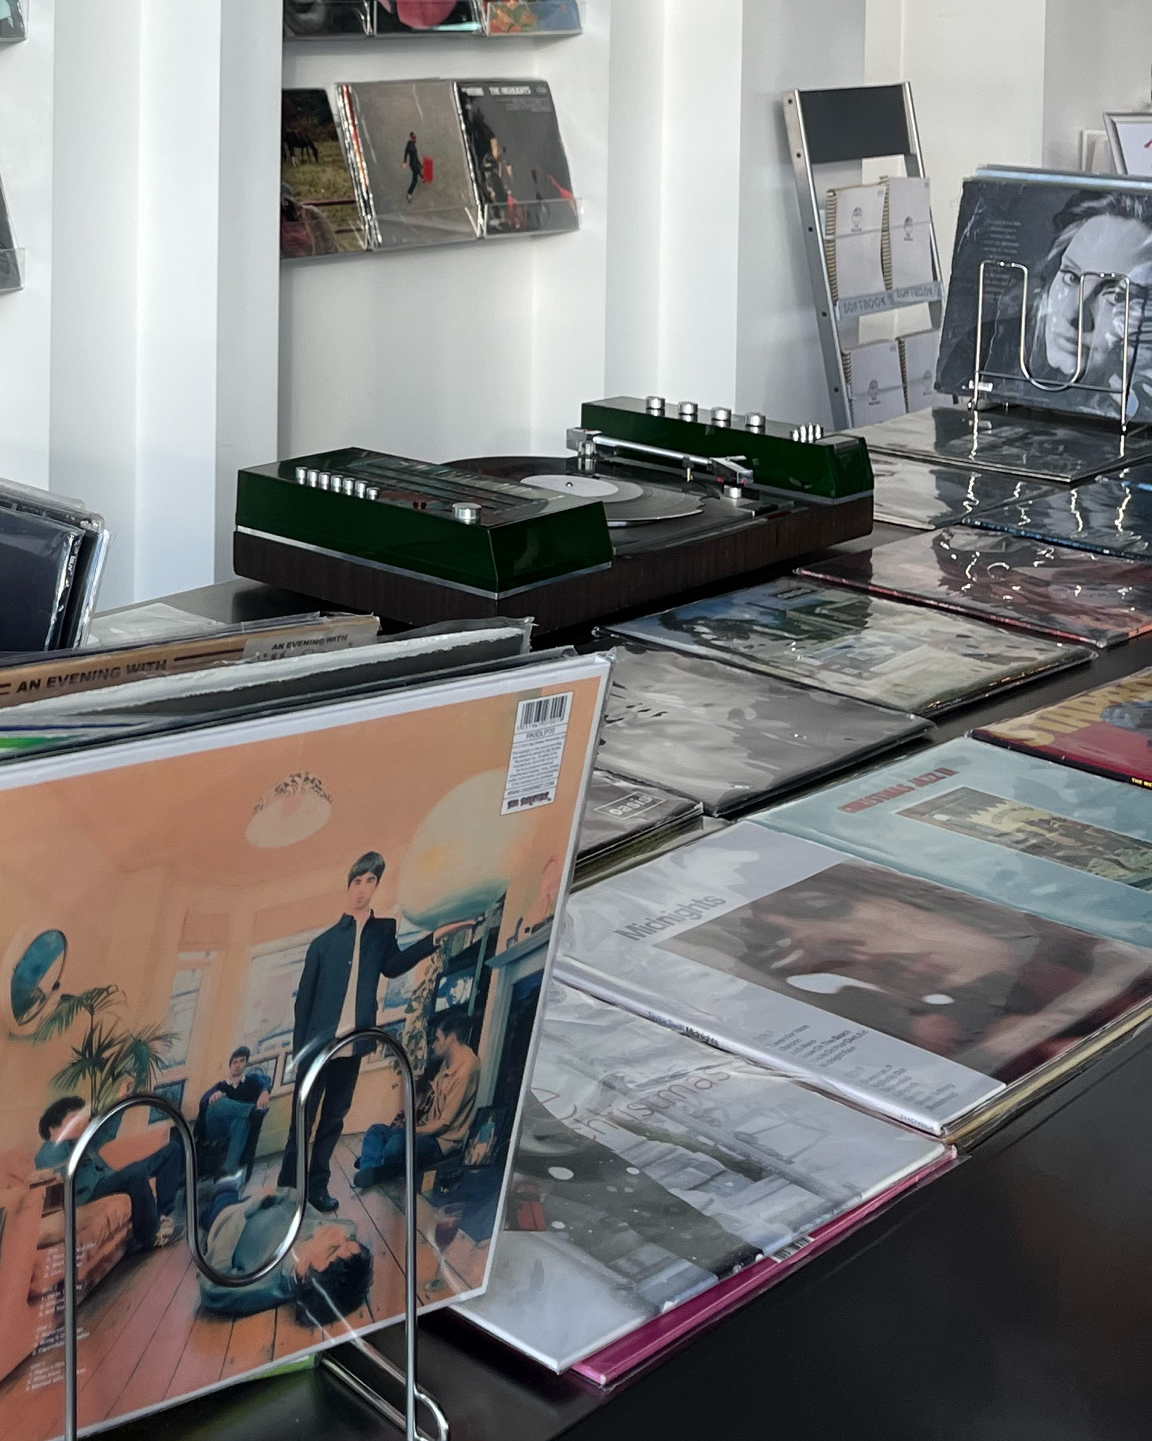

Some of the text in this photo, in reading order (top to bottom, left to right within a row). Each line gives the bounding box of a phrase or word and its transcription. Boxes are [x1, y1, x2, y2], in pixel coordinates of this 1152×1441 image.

[272, 634, 348, 651] AN EVENING WITH
[16, 659, 168, 693] AN EVENING WITH
[609, 795, 652, 815] oasis
[613, 895, 727, 941] Midnights
